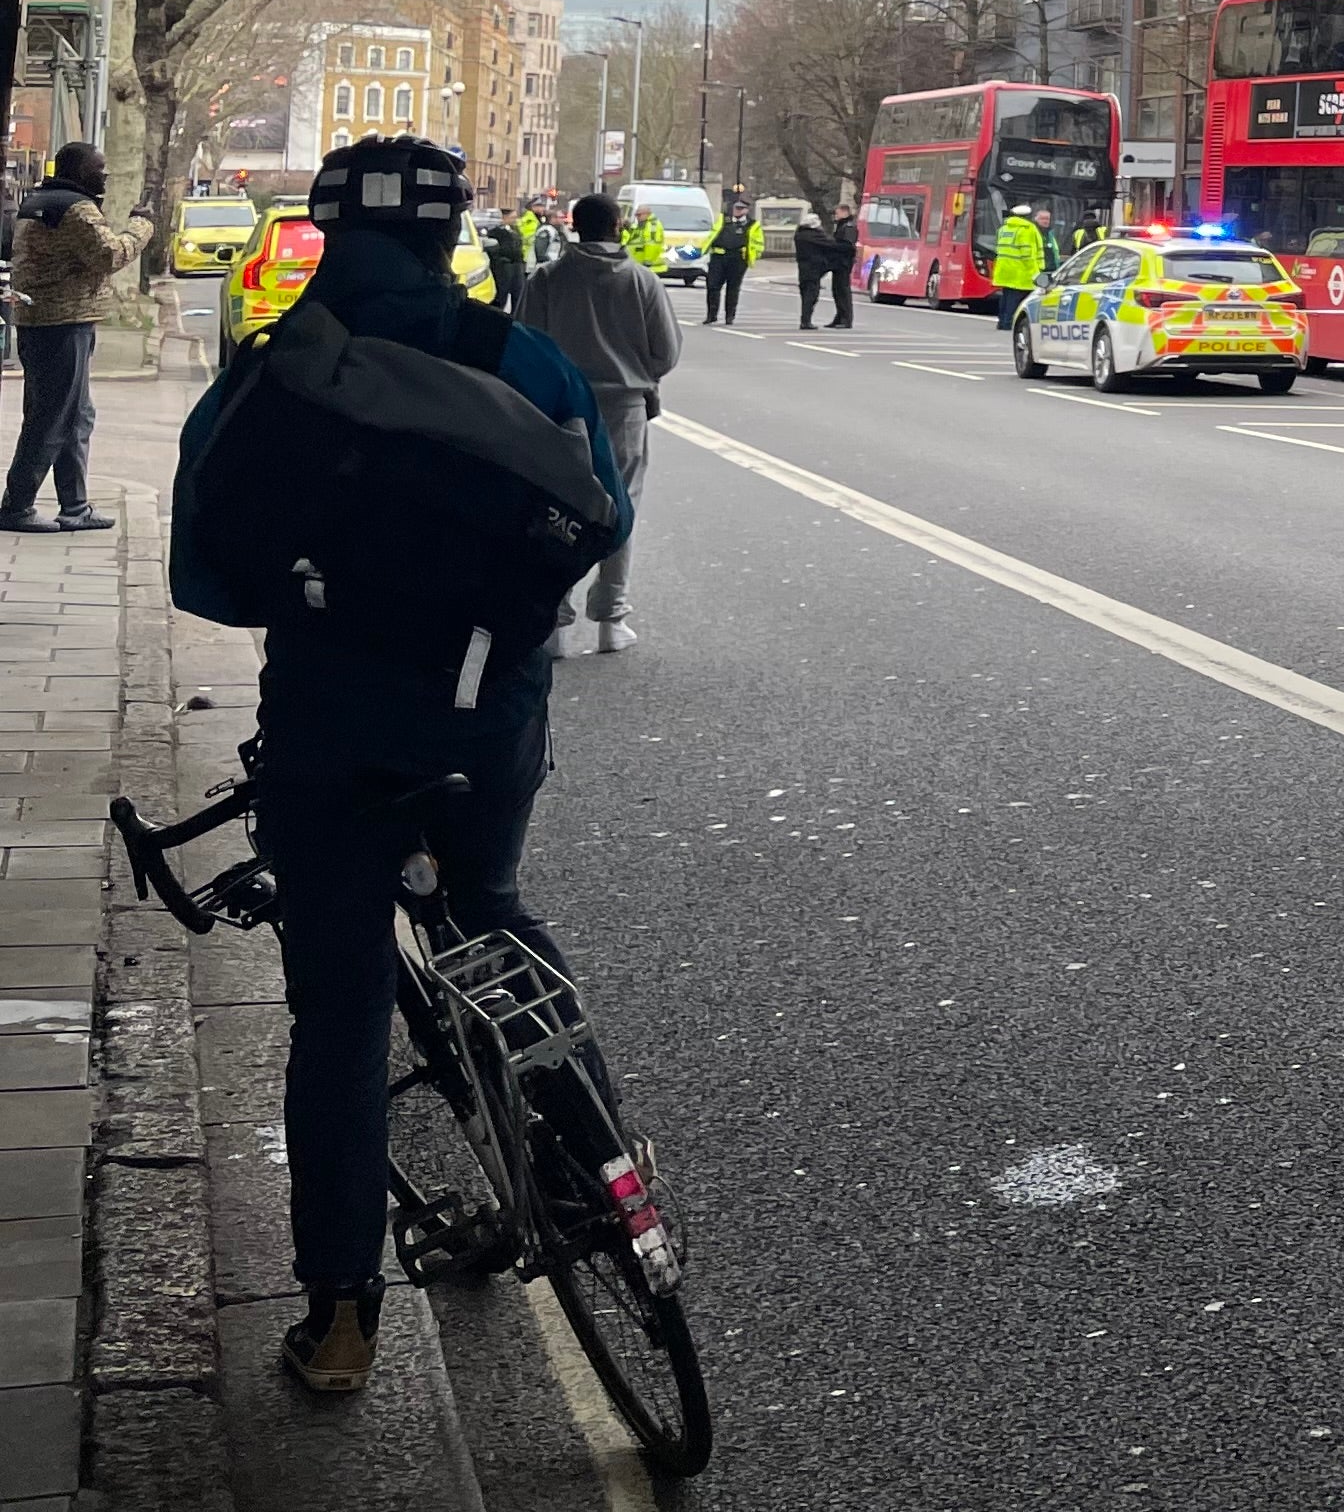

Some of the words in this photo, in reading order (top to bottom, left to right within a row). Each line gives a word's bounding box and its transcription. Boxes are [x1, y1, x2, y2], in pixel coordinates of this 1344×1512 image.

[1007, 156, 1036, 169] Grove
[1036, 159, 1057, 171] Park
[1074, 160, 1096, 177] 136
[1041, 324, 1090, 340] POLICE
[1198, 342, 1266, 352] POLICE
